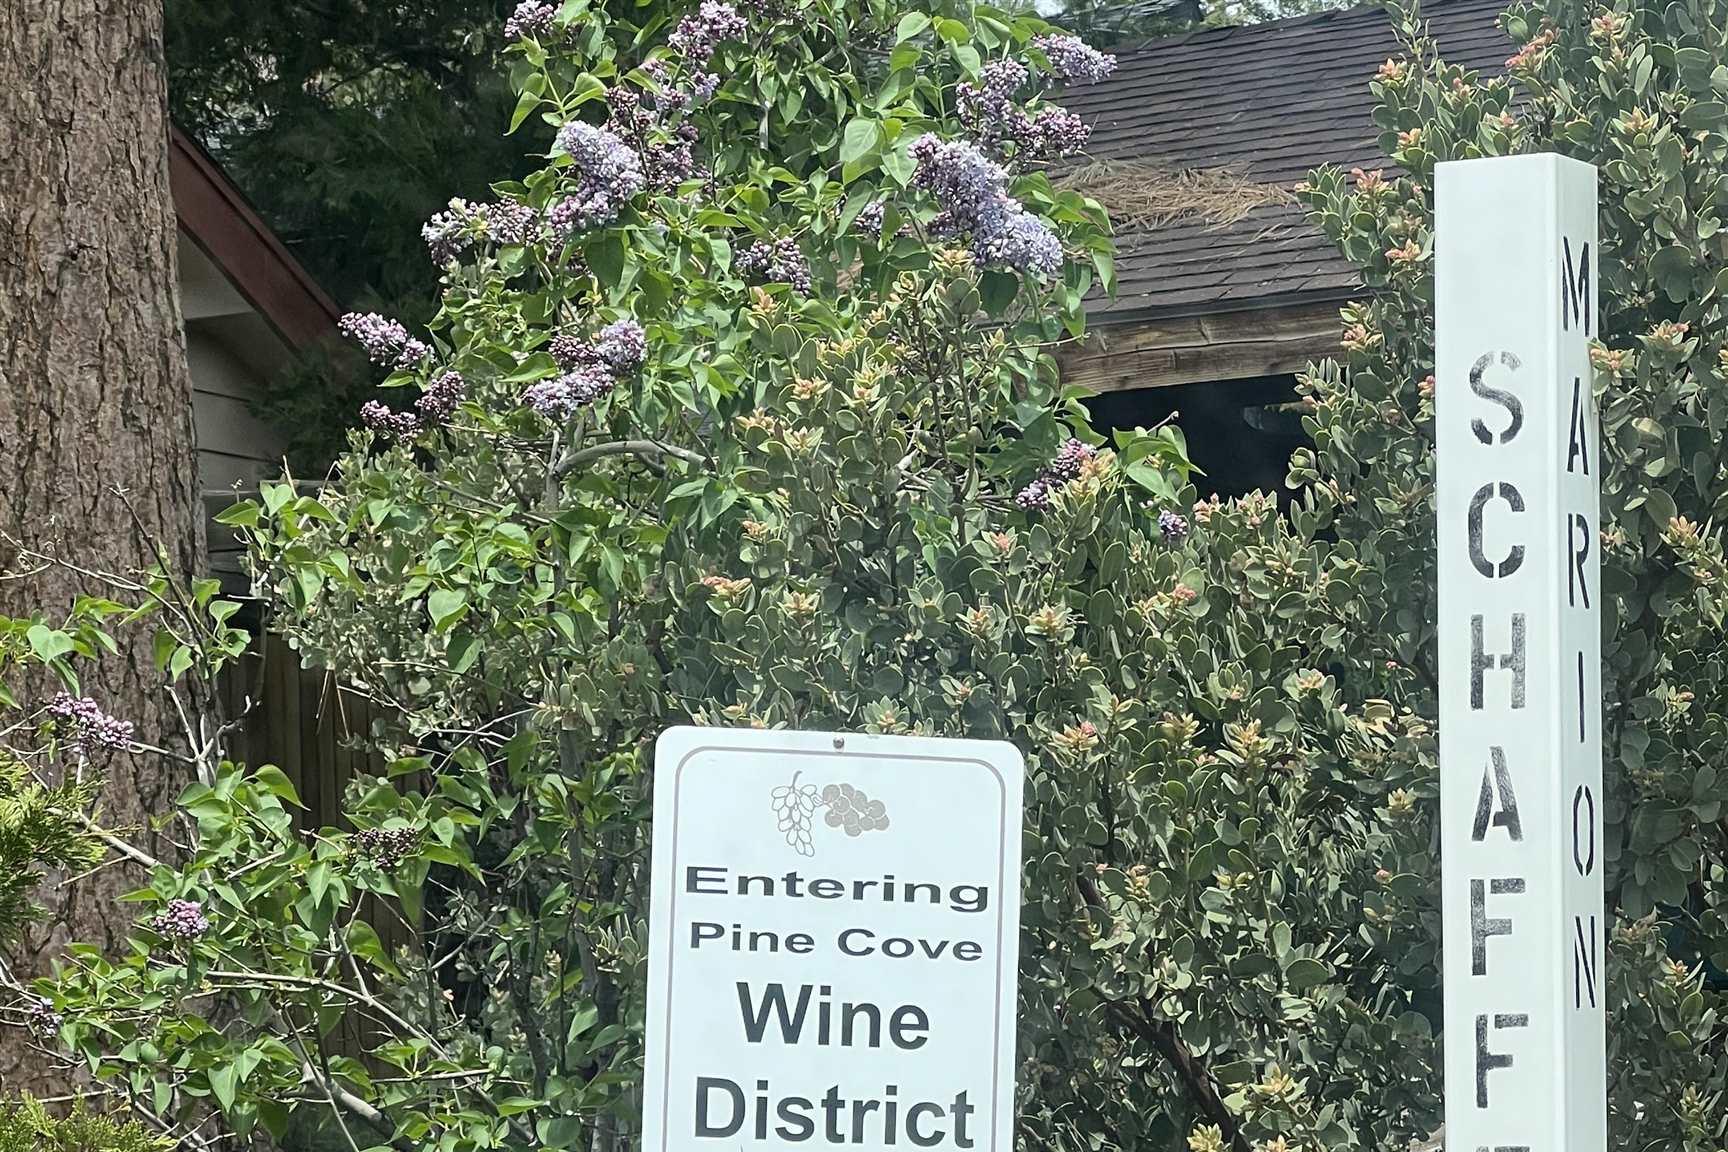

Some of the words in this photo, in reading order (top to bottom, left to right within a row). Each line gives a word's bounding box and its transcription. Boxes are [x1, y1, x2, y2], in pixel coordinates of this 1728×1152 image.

[1562, 236, 1596, 1010] MARION
[685, 866, 989, 913] Entering
[690, 922, 816, 954] Pine
[837, 928, 983, 962] Cove
[736, 981, 930, 1050] Wine
[694, 1076, 975, 1149] District
